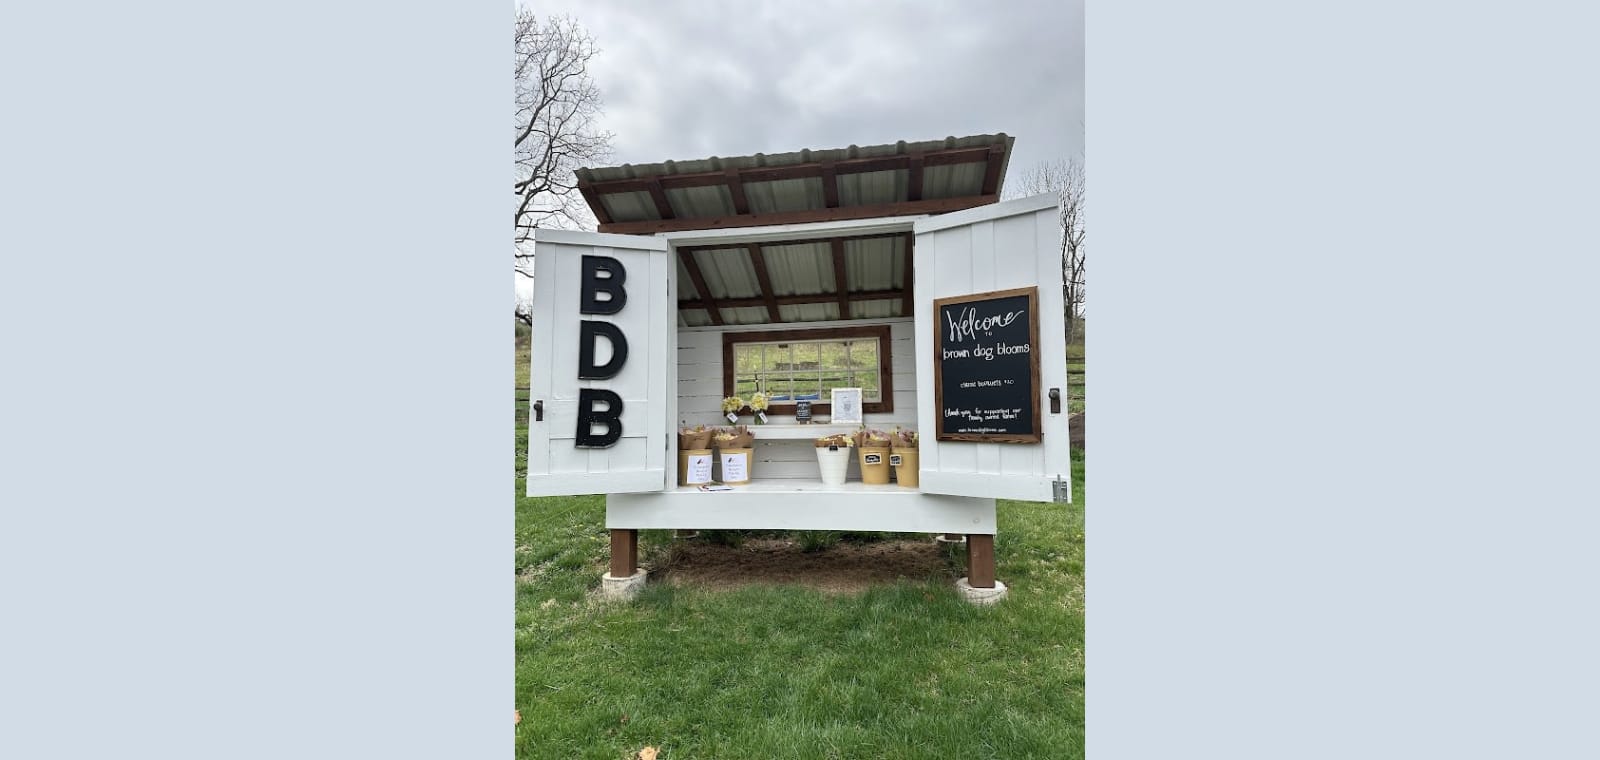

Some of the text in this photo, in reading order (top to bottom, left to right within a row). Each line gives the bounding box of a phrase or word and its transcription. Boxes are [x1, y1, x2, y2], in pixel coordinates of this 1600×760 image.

[946, 306, 1024, 342] Welcome
[943, 341, 1030, 361] brown dog blooms
